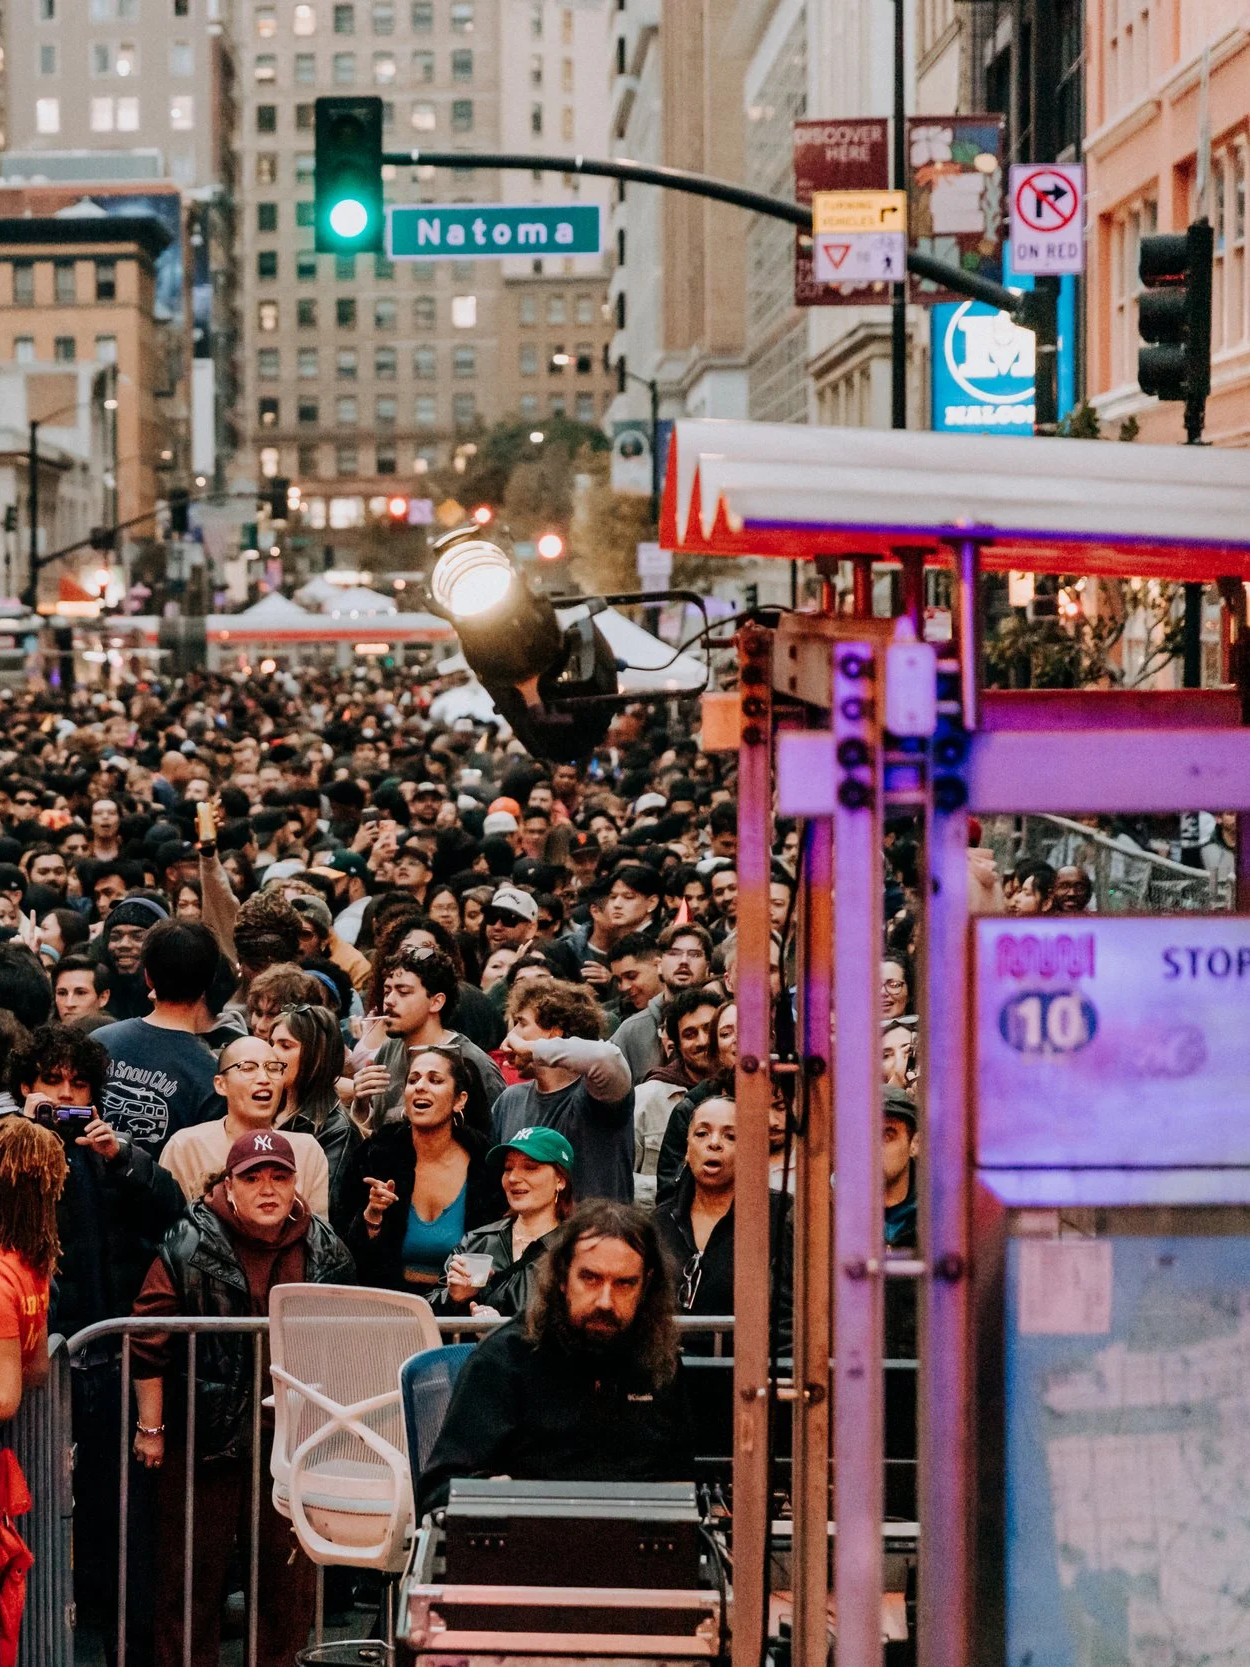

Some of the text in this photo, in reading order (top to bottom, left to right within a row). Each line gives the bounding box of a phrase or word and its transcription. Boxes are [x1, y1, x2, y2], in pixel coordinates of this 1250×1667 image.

[417, 218, 574, 246] Natoma
[1017, 242, 1078, 260] ON RED
[1017, 995, 1084, 1049] 10
[114, 1060, 152, 1084] Snow
[149, 1070, 179, 1098] Club
[254, 1134, 273, 1151] NY
